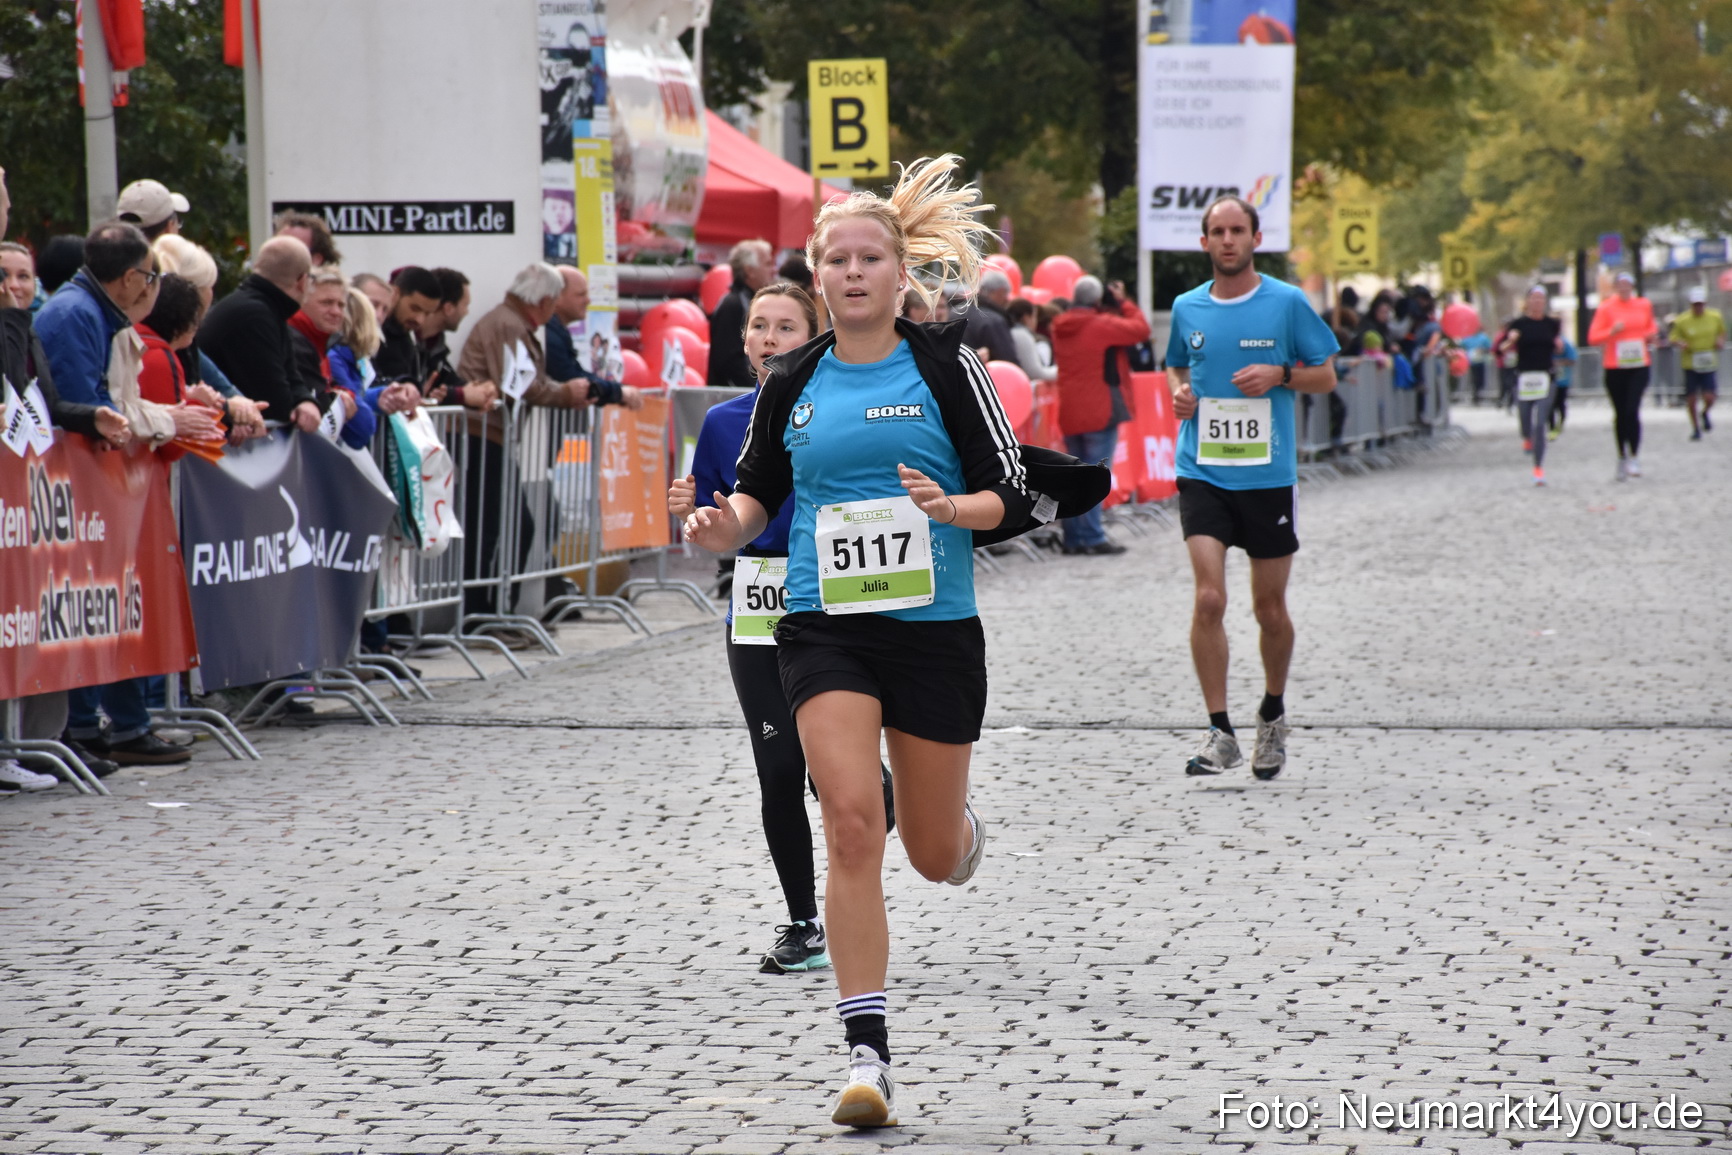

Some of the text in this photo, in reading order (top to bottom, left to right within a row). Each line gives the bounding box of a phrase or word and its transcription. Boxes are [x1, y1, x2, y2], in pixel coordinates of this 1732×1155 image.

[819, 66, 877, 86] Block
[831, 97, 868, 151] B
[1345, 223, 1366, 255] C
[1451, 256, 1468, 279] D
[1240, 339, 1275, 348] BOCK
[865, 404, 925, 420] BOCK
[1209, 419, 1259, 439] 5118
[852, 508, 894, 521] BOCK
[192, 532, 286, 586] RAIL.ONE
[832, 532, 912, 571] 5117
[768, 565, 788, 574] BOC
[861, 580, 889, 593] Julia
[746, 585, 788, 611] 500
